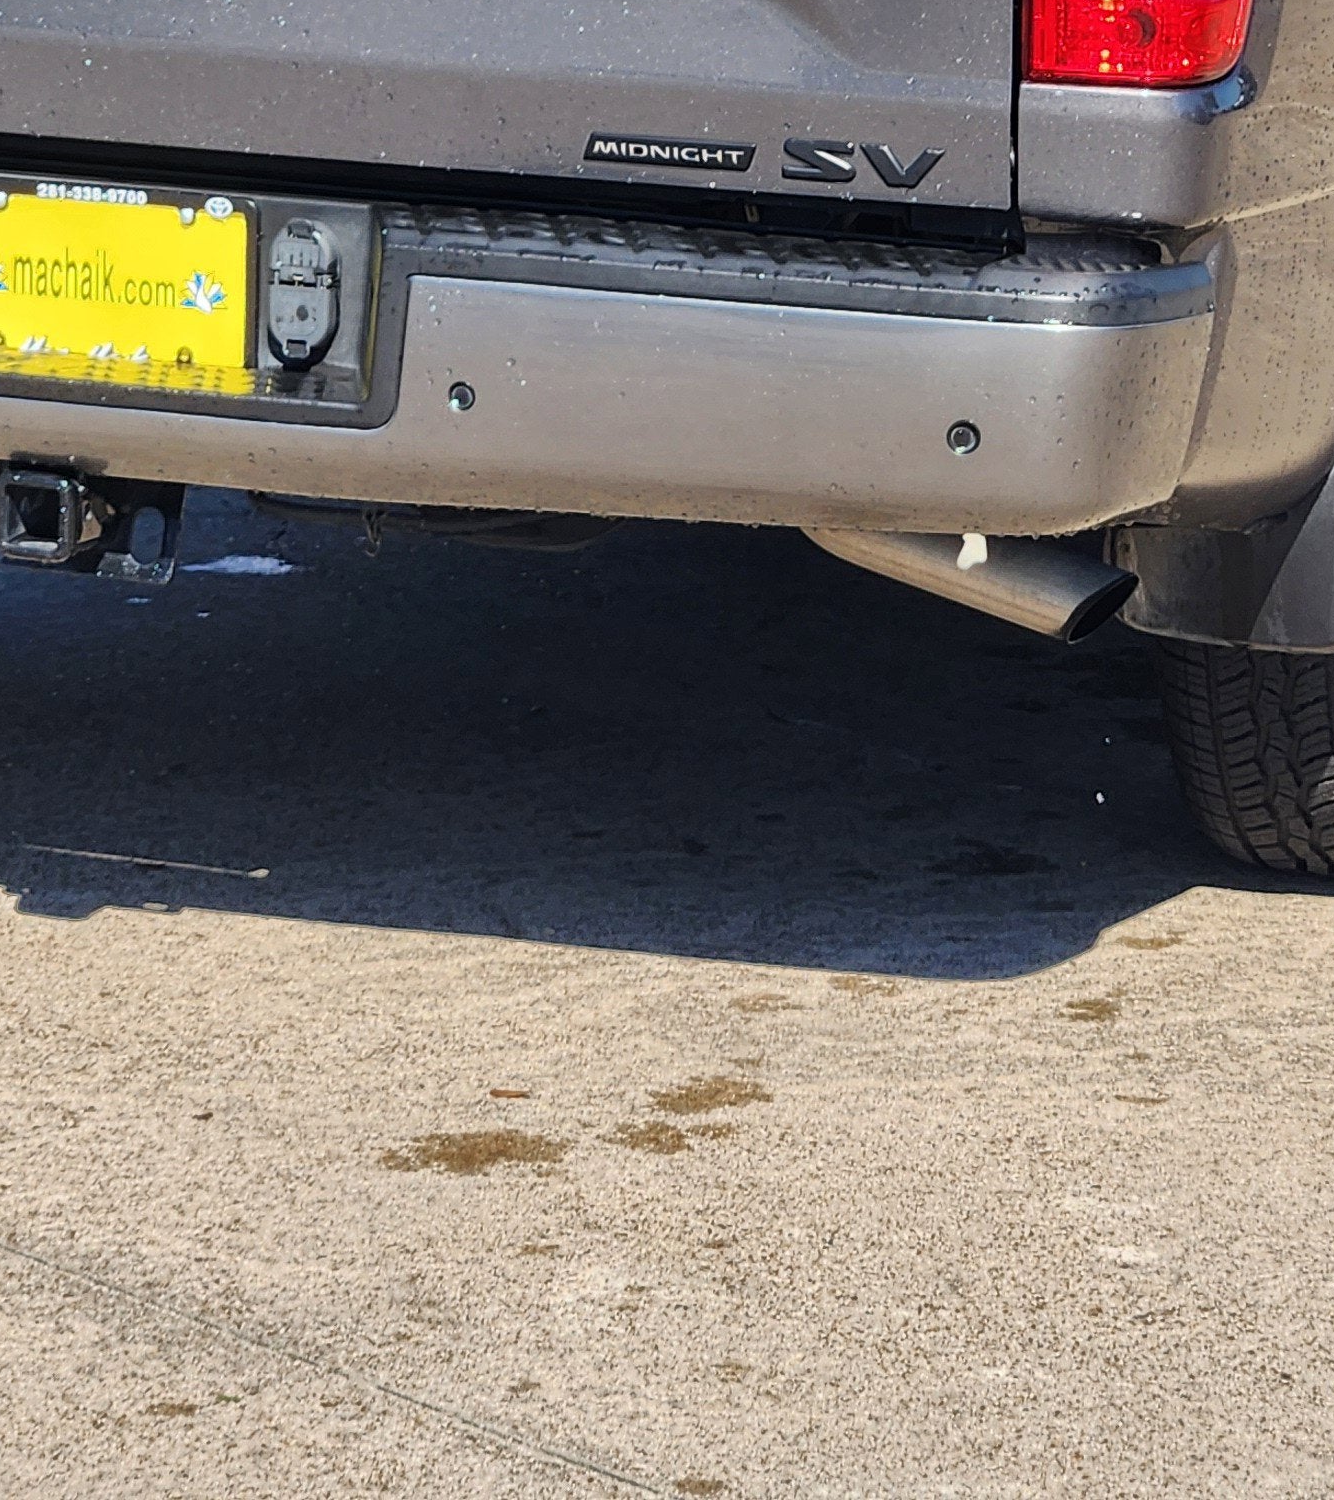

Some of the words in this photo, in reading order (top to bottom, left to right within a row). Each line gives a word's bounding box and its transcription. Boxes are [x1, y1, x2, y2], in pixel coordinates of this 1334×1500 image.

[592, 140, 745, 166] MIDNIGHT
[782, 137, 947, 189] SV
[12, 247, 176, 308] machaik.com
